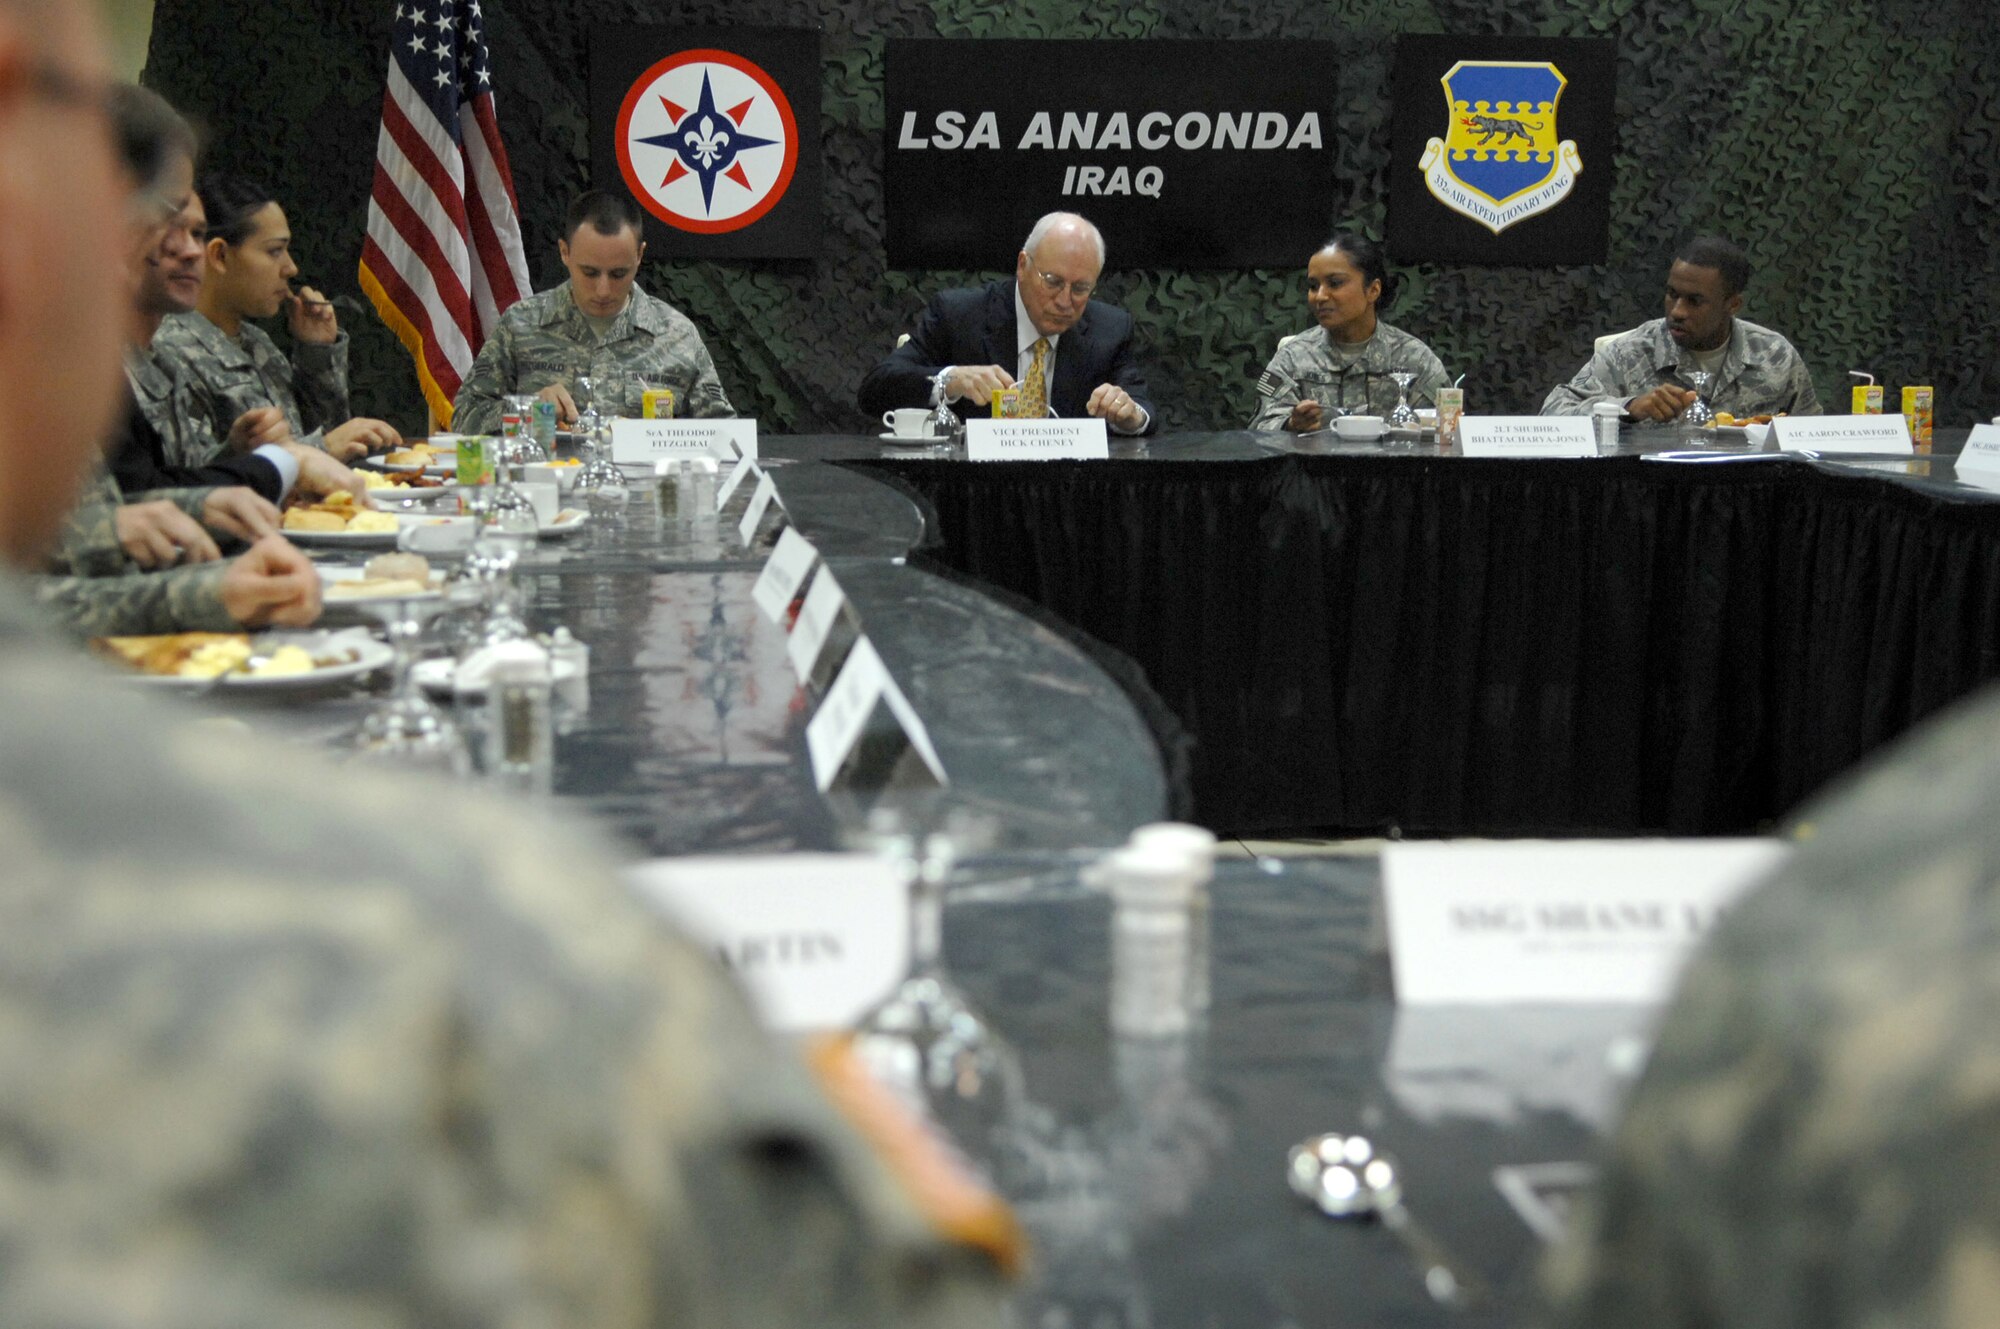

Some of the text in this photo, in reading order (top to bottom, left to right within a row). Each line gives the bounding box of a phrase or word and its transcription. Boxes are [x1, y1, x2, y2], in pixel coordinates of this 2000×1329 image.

[898, 111, 1323, 150] LSA ANACONDA
[1061, 166, 1164, 199] IRAQ
[1450, 189, 1465, 205] AIR
[1466, 192, 1542, 225] EXPEDITIONARY
[1542, 174, 1569, 200] WING
[645, 429, 717, 437] SrA THEODOR
[992, 428, 1081, 436] VICE PRESIDENT
[1494, 425, 1560, 433] 2LT SHUBHRA
[1807, 430, 1841, 438] AARON
[1842, 428, 1899, 438] CRAWFORD
[652, 440, 709, 448] FITZGERAL
[1000, 439, 1075, 447] DICK CHENEY
[1534, 901, 1667, 934] SHANE
[718, 929, 847, 967] ARTIN
